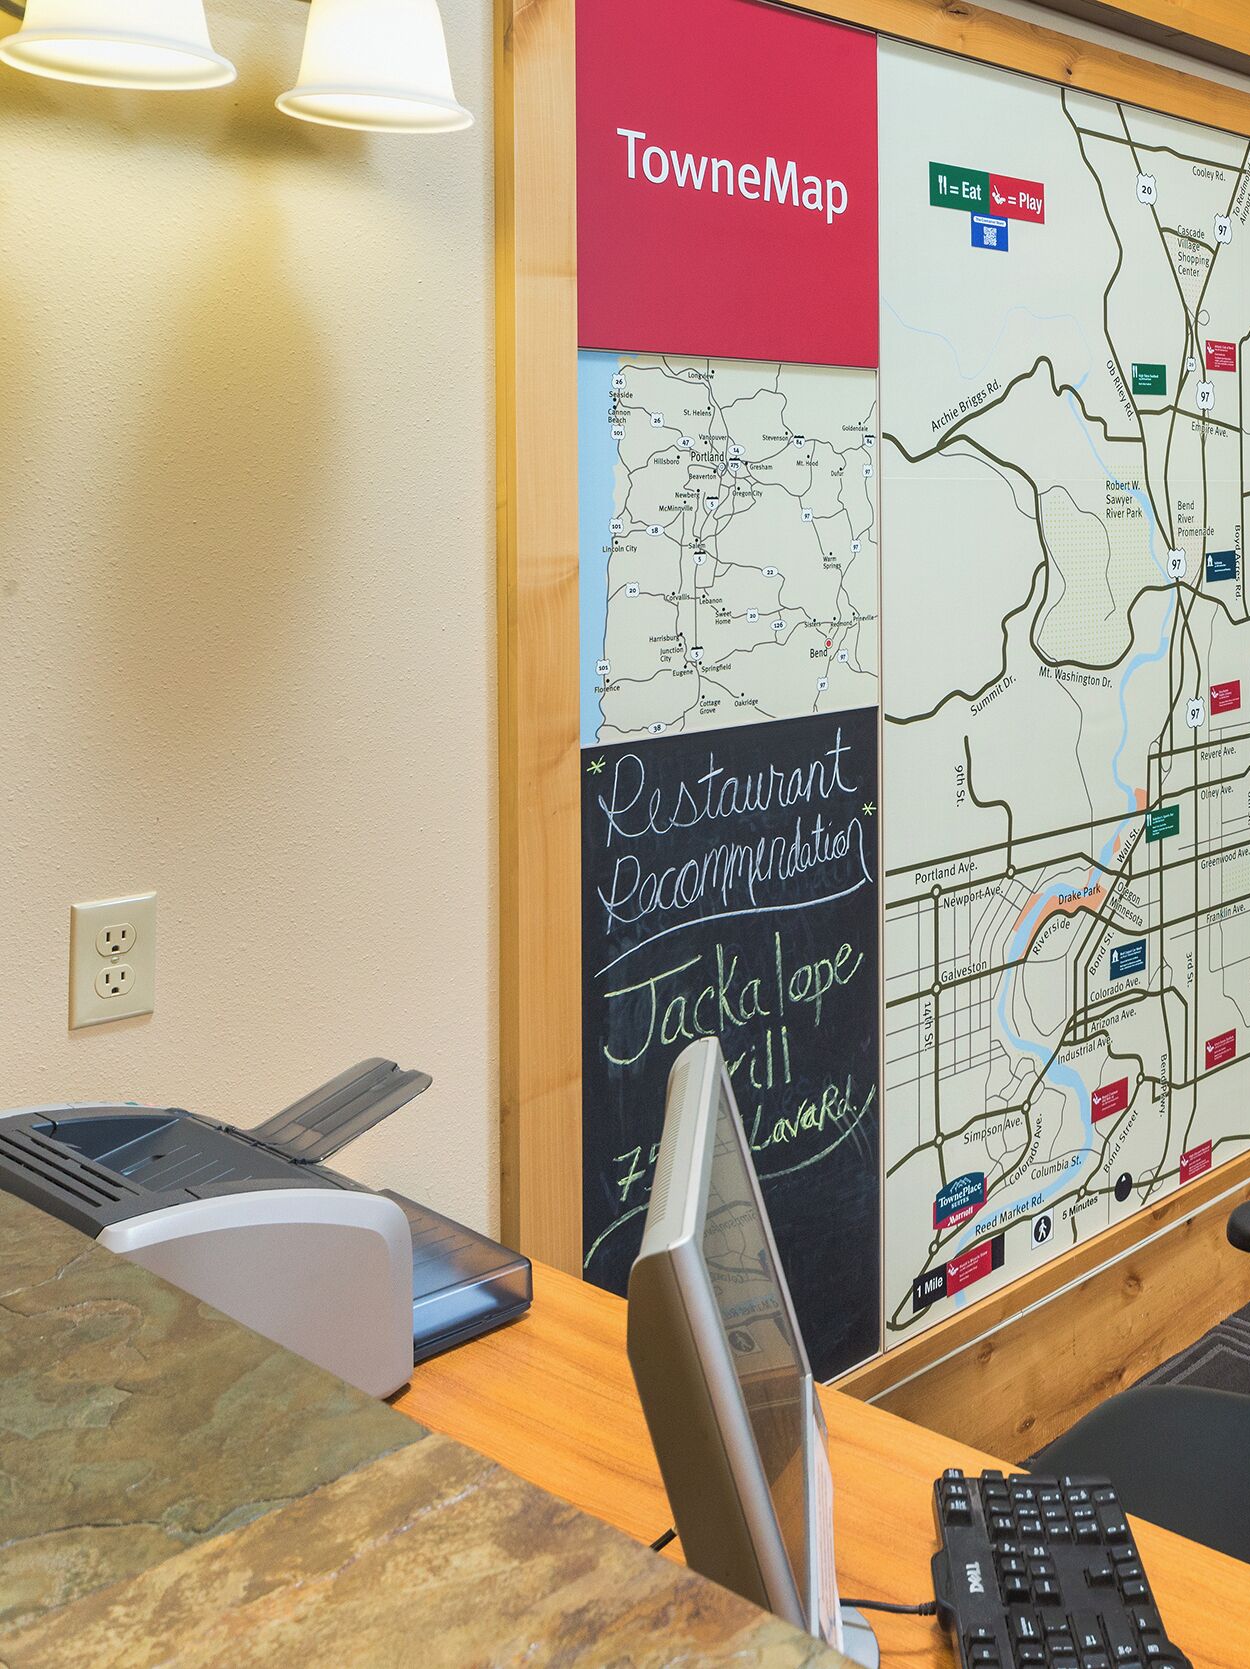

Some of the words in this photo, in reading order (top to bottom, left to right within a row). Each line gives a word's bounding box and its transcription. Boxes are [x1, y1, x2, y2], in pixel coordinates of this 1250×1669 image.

[616, 127, 848, 224] TowneMap
[1192, 166, 1215, 181] Cooley
[1215, 171, 1226, 182] Rd.
[962, 181, 982, 201] Eat
[1141, 185, 1152, 195] 20
[1019, 192, 1043, 214] Play
[1233, 206, 1241, 217] To
[1177, 225, 1205, 239] Cascade
[1218, 225, 1227, 236] 97
[1177, 238, 1200, 252] Village
[1177, 252, 1210, 268] Shopping
[1177, 265, 1200, 277] Center
[609, 391, 634, 399] Seaside
[1106, 359, 1116, 377] Ob
[1113, 376, 1127, 404] Riley
[1124, 402, 1134, 421] Rd.
[1200, 391, 1210, 402] 97
[607, 408, 632, 416] Cannon
[931, 406, 959, 432] Archie
[958, 388, 987, 413] Briggs
[987, 379, 1002, 395] Rd.
[607, 416, 627, 424] Beach
[1191, 421, 1214, 435] Empire
[1214, 427, 1229, 437] Ave.
[762, 434, 789, 442] Stevenson
[690, 451, 725, 462] Portland
[750, 463, 773, 471] Gresham
[1105, 480, 1131, 491] Robert
[1132, 481, 1141, 490] W.
[1105, 494, 1133, 505] Sawyer
[1177, 500, 1195, 511] Bend
[1105, 508, 1125, 519] River
[1126, 508, 1143, 518] Park
[1177, 514, 1195, 524] River
[1177, 526, 1215, 537] Promenade
[602, 545, 624, 553] Lincoln
[625, 545, 637, 553] City
[1171, 559, 1181, 570] 97
[665, 593, 690, 601] Corvallis
[649, 634, 680, 643] Harrisburg
[810, 648, 828, 658] Bend
[672, 669, 694, 677] Eugene
[701, 663, 732, 673] Springfield
[1038, 666, 1053, 679] Mt.
[1054, 668, 1100, 687] Washington
[1101, 676, 1113, 689] Dr.
[594, 684, 621, 693] Florence
[970, 684, 1004, 717] Summit
[1002, 674, 1017, 690] Dr.
[699, 699, 721, 708] Cottage
[699, 707, 716, 715] Grove
[734, 698, 759, 707] Oakridge
[1190, 708, 1200, 719] 97
[1200, 750, 1222, 761] Revere
[1222, 746, 1236, 757] Ave.
[954, 765, 965, 787] 9th
[598, 727, 858, 847] Restaurant
[1200, 788, 1221, 801] Olney
[1221, 784, 1234, 796] Ave.
[956, 789, 966, 807] St.
[1117, 840, 1132, 863] Wall
[1129, 828, 1140, 841] St.
[1200, 851, 1237, 870] Greenwood
[1237, 847, 1250, 859] Ave.
[597, 813, 873, 935] Recommendation
[915, 864, 956, 885] Portland
[958, 860, 978, 874] Ave.
[943, 887, 981, 909] Newport
[982, 885, 1004, 898] Ave.
[1058, 889, 1082, 905] Drake
[1083, 883, 1101, 899] Park
[1117, 881, 1141, 905] Oregon
[1108, 896, 1144, 927] Minnesota
[1206, 905, 1231, 923] Franklin
[1232, 902, 1246, 914] Ave.
[1033, 918, 1070, 956] Riverside
[1088, 949, 1107, 976] Bond
[1104, 931, 1115, 947] St.
[941, 961, 987, 983] Galveston
[604, 931, 864, 1065] Jackalope
[1090, 982, 1124, 1003] Colorado
[1125, 976, 1141, 989] Ave.
[922, 1001, 933, 1029] 14th
[1090, 1014, 1120, 1033] Arizona
[1121, 1008, 1137, 1021] Ave.
[924, 1030, 934, 1051] St.
[1057, 1041, 1096, 1065] Industrial
[1096, 1036, 1113, 1049] Ave.
[963, 1123, 1003, 1145] Simpson
[1004, 1116, 1023, 1129] Ave.
[1009, 1140, 1040, 1186] Colorado
[1034, 1113, 1042, 1139] Ave.
[1103, 1145, 1121, 1174] Bond
[1119, 1110, 1139, 1142] Street
[1031, 1161, 1069, 1181] Columbia
[1070, 1155, 1082, 1167] St.
[938, 1182, 982, 1208] TownePlace
[948, 1205, 974, 1227] Marriott
[975, 1214, 997, 1236] Reed
[999, 1201, 1029, 1224] Market
[1031, 1193, 1045, 1208] Rd.
[1062, 1208, 1068, 1220] 5
[1069, 1194, 1099, 1218] Minutes
[917, 1285, 922, 1298] 1
[924, 1276, 944, 1294] Mile
